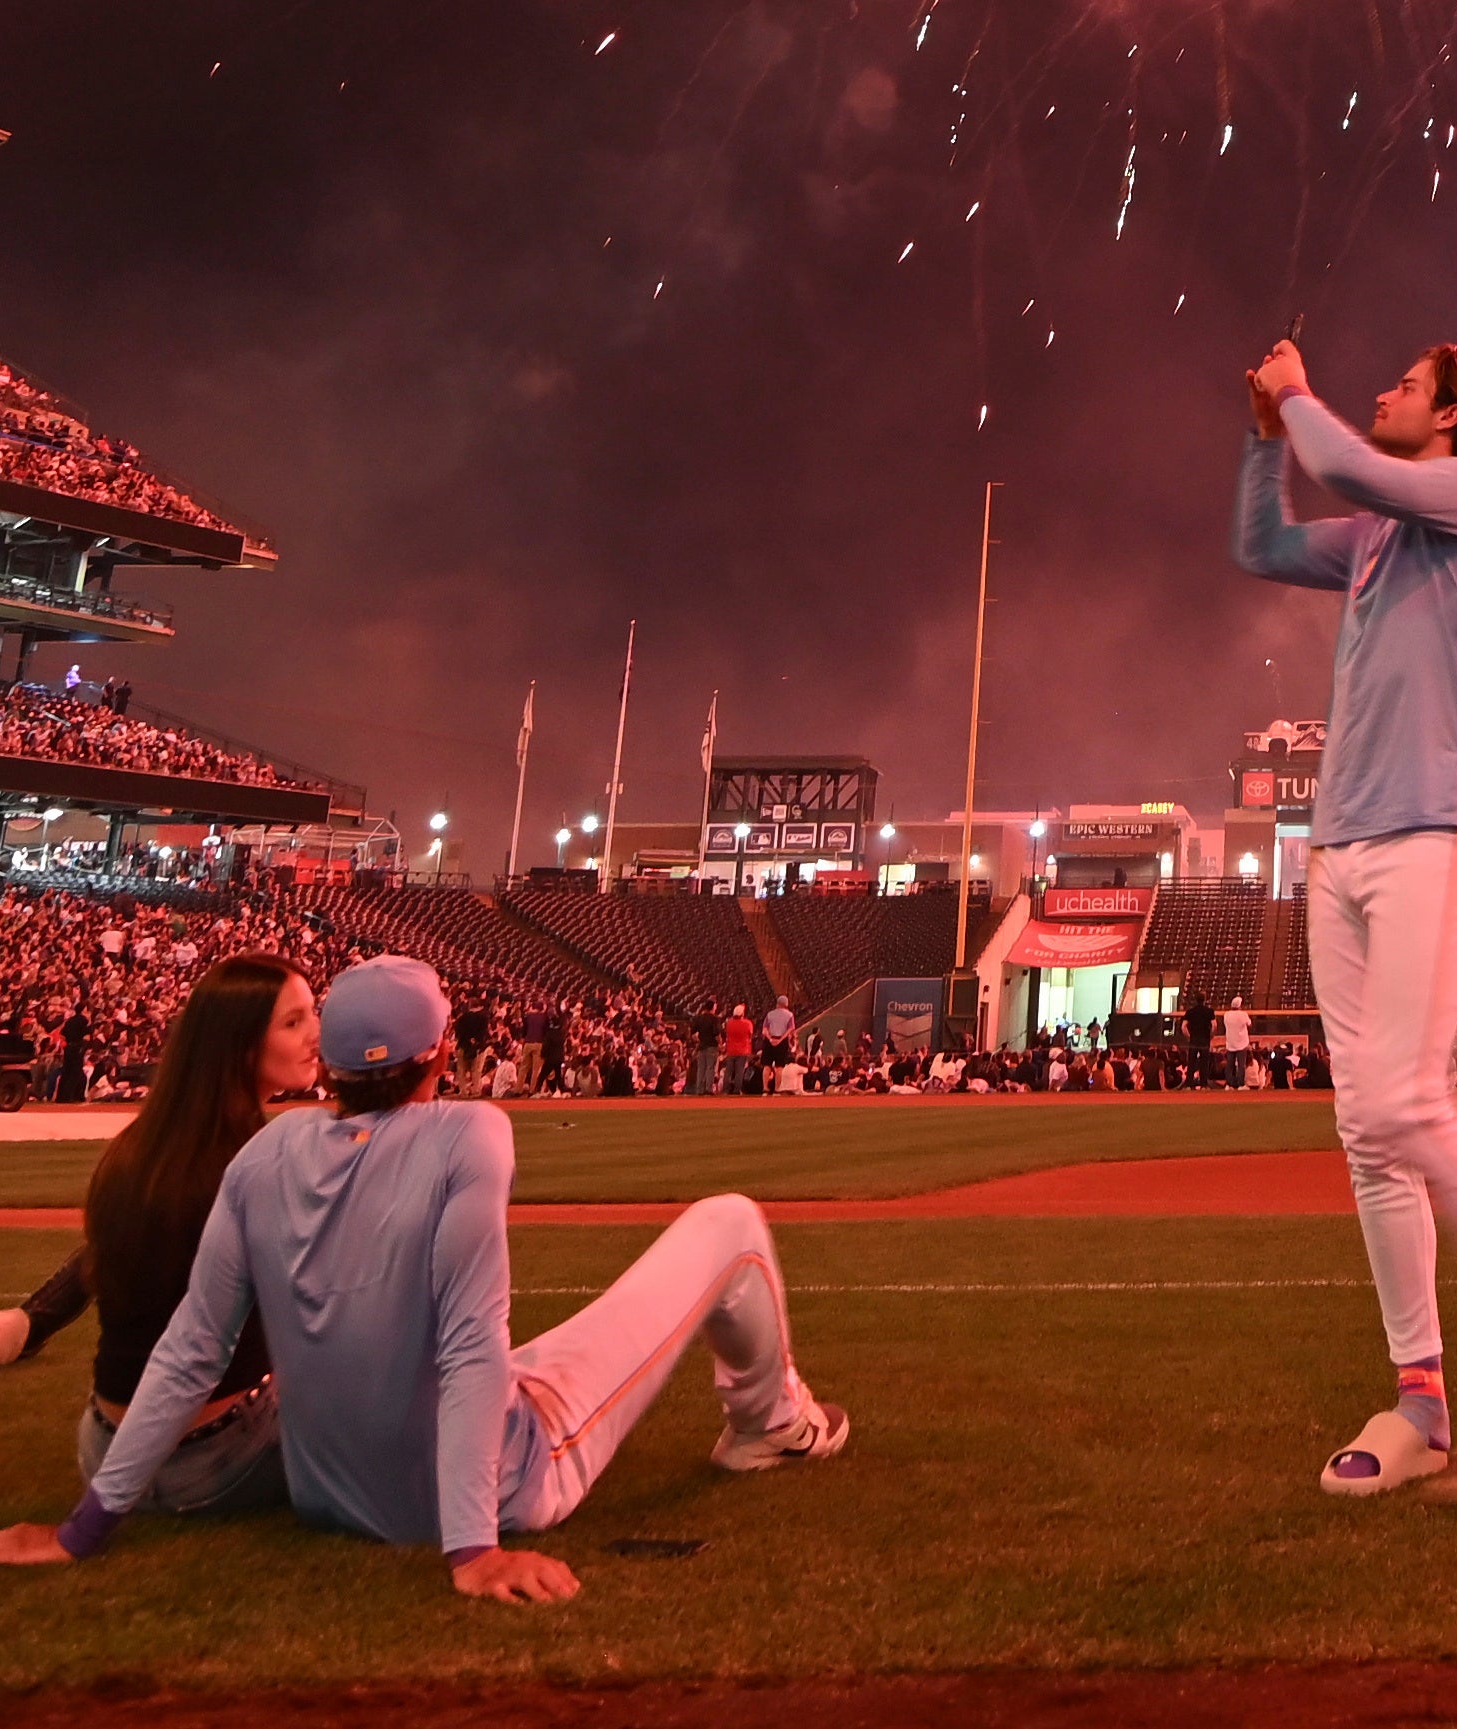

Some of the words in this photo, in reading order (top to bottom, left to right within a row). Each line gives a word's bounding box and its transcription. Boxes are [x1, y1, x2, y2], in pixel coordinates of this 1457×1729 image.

[1069, 824, 1096, 835] EPIC
[1098, 824, 1153, 835] WESTERN
[1055, 890, 1139, 912] uchealth
[1059, 925, 1083, 935] HIT
[1088, 925, 1116, 935] THE
[1024, 947, 1055, 960] FOR
[1058, 945, 1126, 960] CHARITY
[887, 1001, 934, 1012] Chevron
